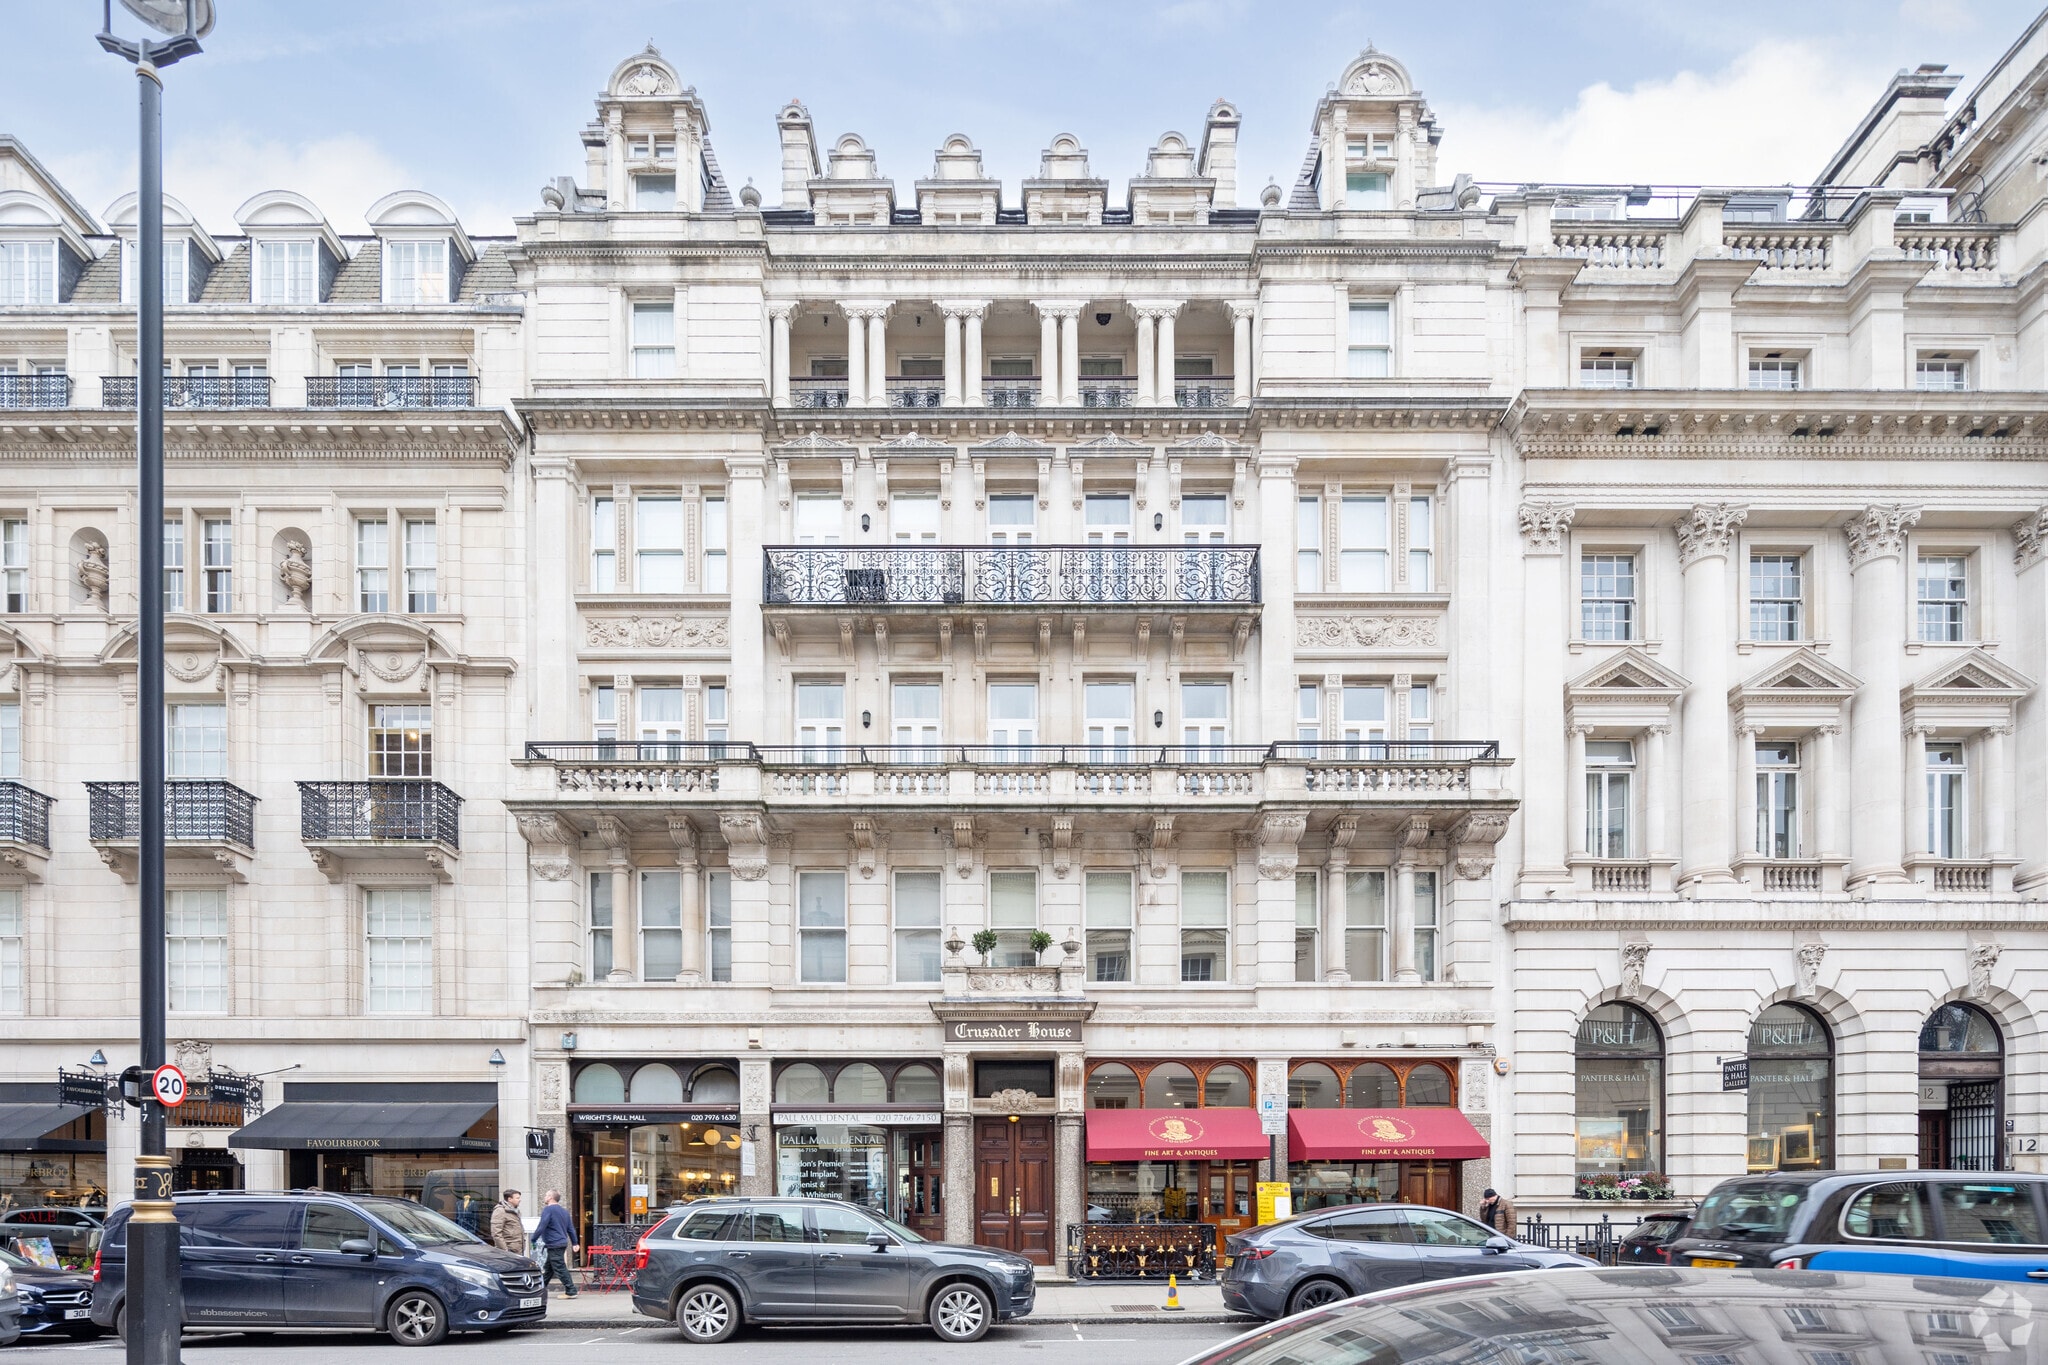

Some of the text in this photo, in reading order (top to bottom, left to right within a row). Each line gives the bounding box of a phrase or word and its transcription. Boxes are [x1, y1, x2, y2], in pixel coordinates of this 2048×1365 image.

[955, 1022, 1071, 1039] Crusader House
[1592, 1028, 1634, 1044] P&H
[1762, 1028, 1802, 1044] P&H
[1724, 1063, 1747, 1073] PANTER
[1730, 1072, 1747, 1080] HALL
[159, 1077, 182, 1095] 20
[1724, 1079, 1747, 1087] GALLERY
[778, 1114, 861, 1122] PALL MALL DENTAL
[875, 1114, 937, 1122] 020 7766 7150
[307, 1139, 381, 1148] FAVOURBROOK
[782, 1136, 882, 1145] PALL MALL DENTAL
[2019, 1139, 2037, 1152] 12
[817, 1160, 845, 1168] Premier
[810, 1170, 839, 1179] Implant,
[806, 1191, 843, 1200] Whitening
[19, 1211, 57, 1222] SALE
